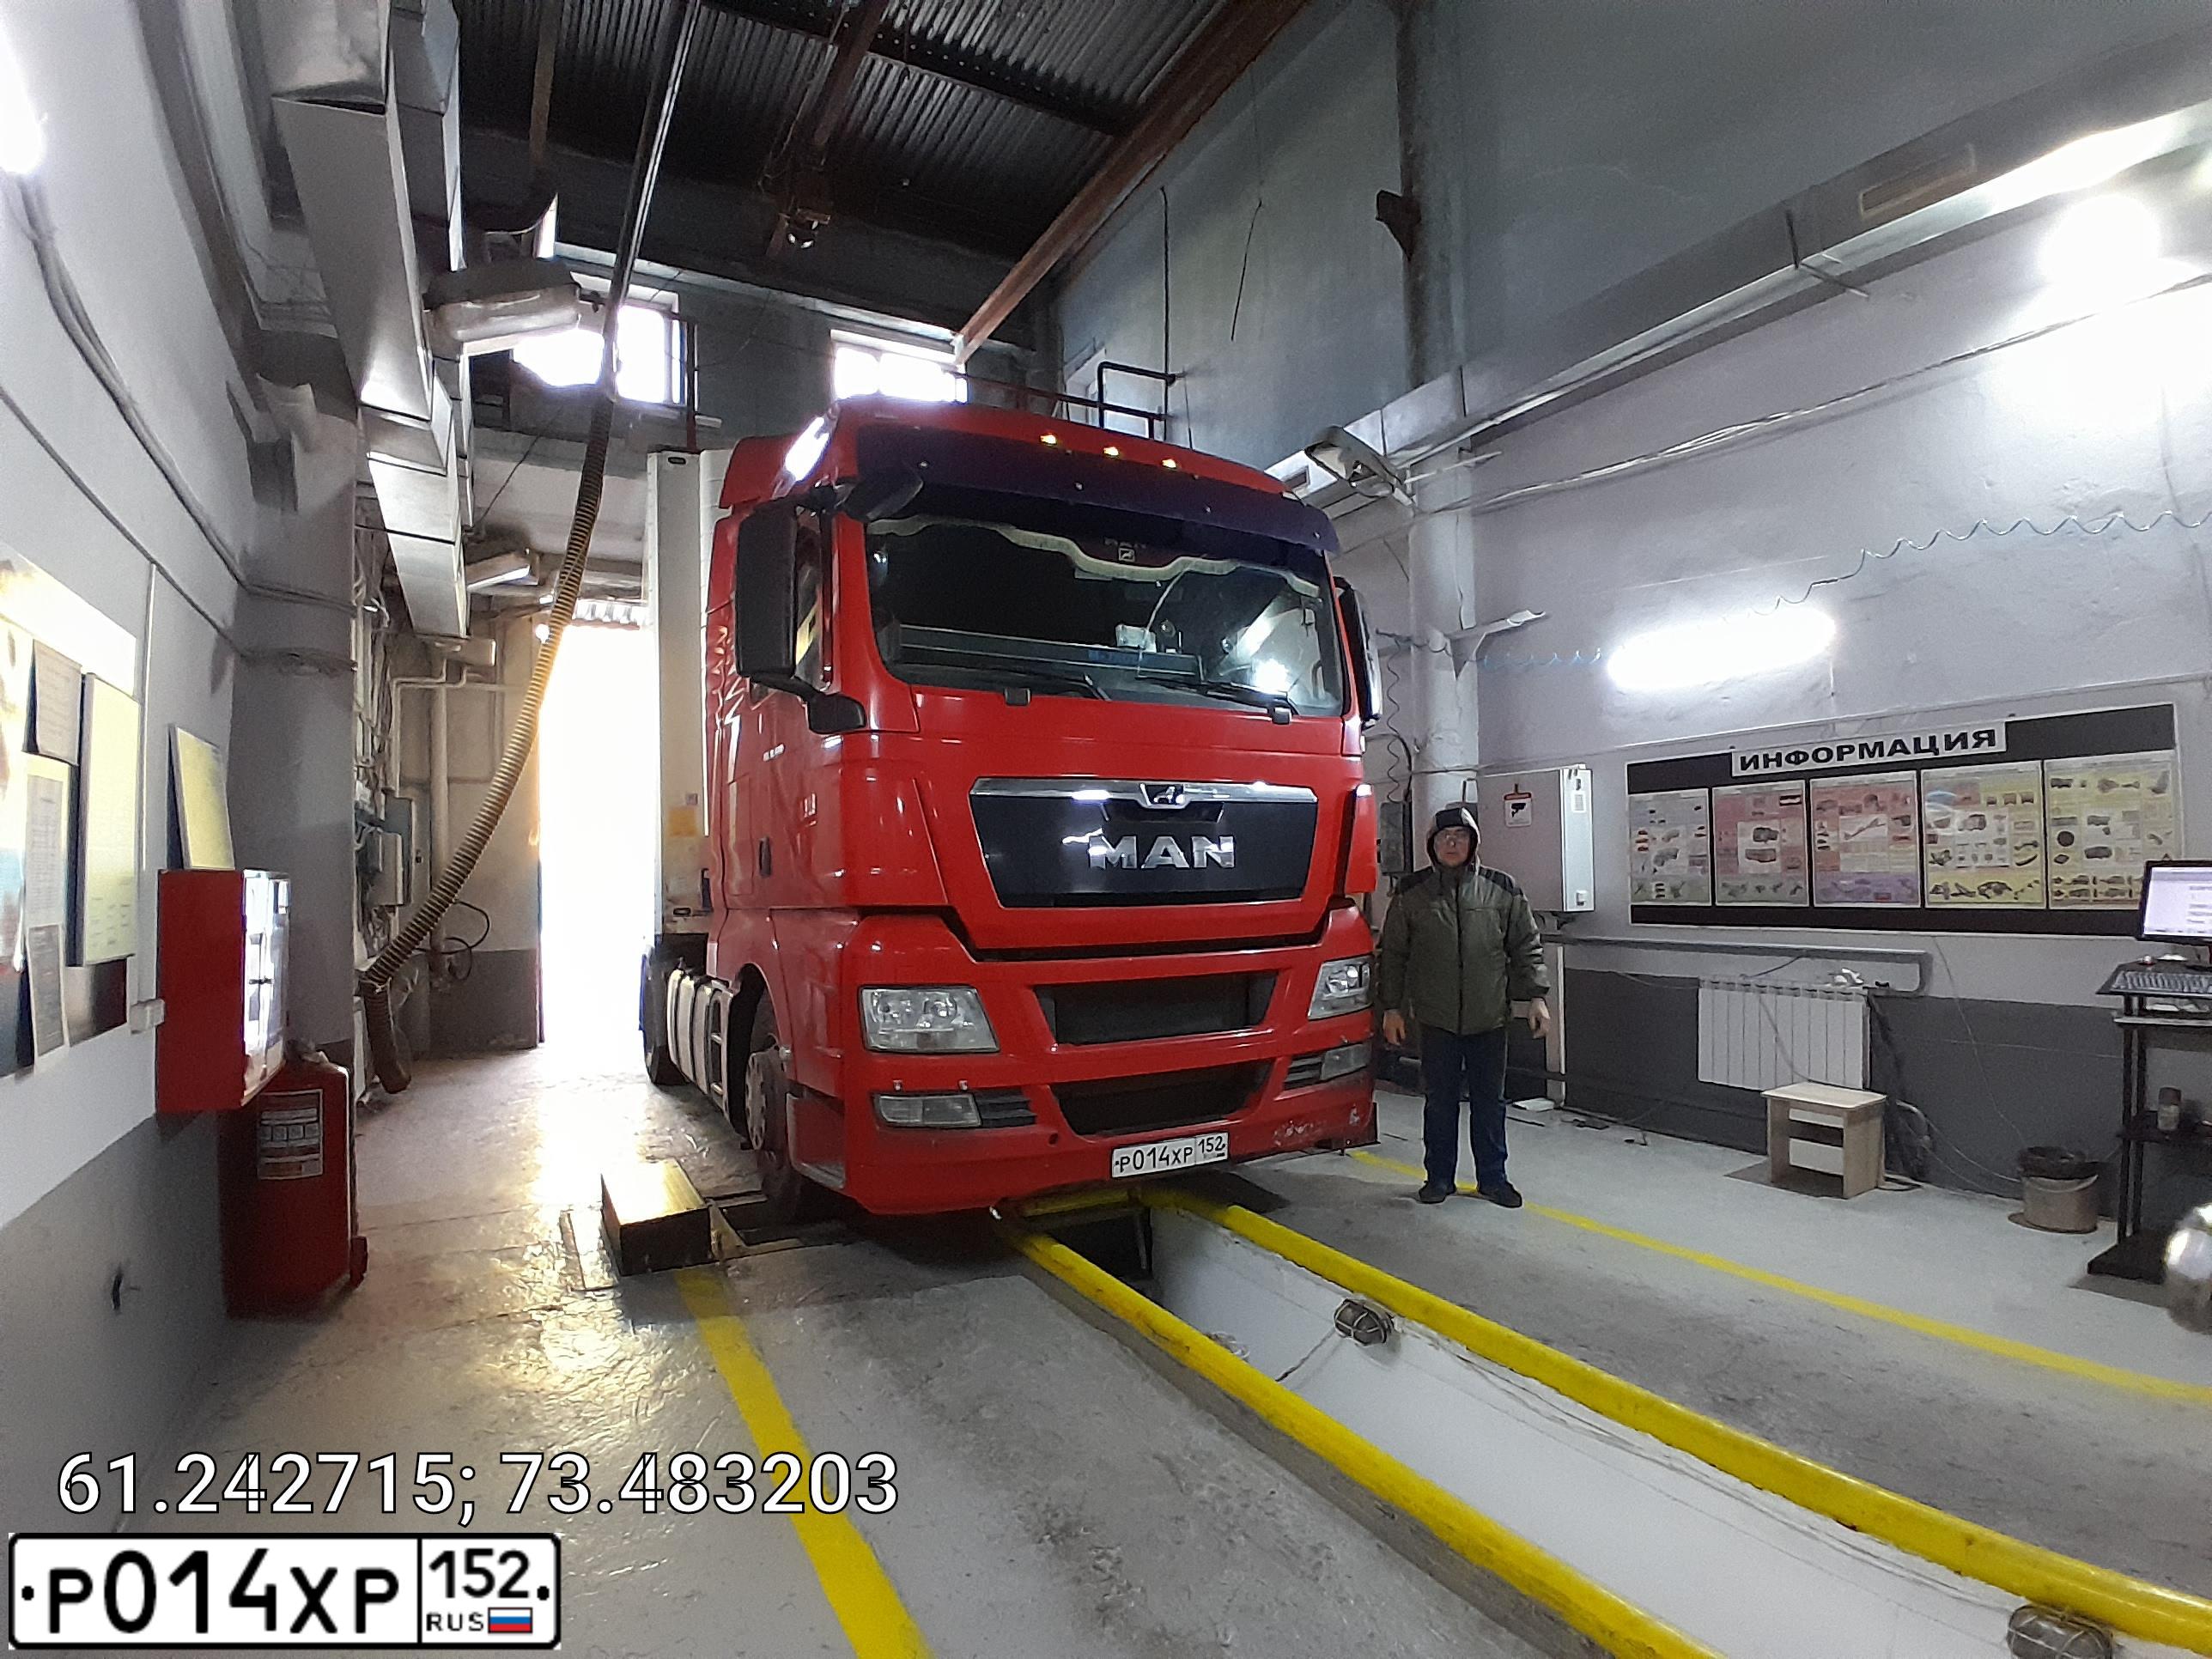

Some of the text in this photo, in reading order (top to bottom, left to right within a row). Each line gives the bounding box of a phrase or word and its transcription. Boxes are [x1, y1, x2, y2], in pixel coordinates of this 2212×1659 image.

[1740, 729, 1996, 771] ИНФОРМАЦИЯ
[1088, 836, 1235, 869] MAN
[1198, 1135, 1223, 1154] 152
